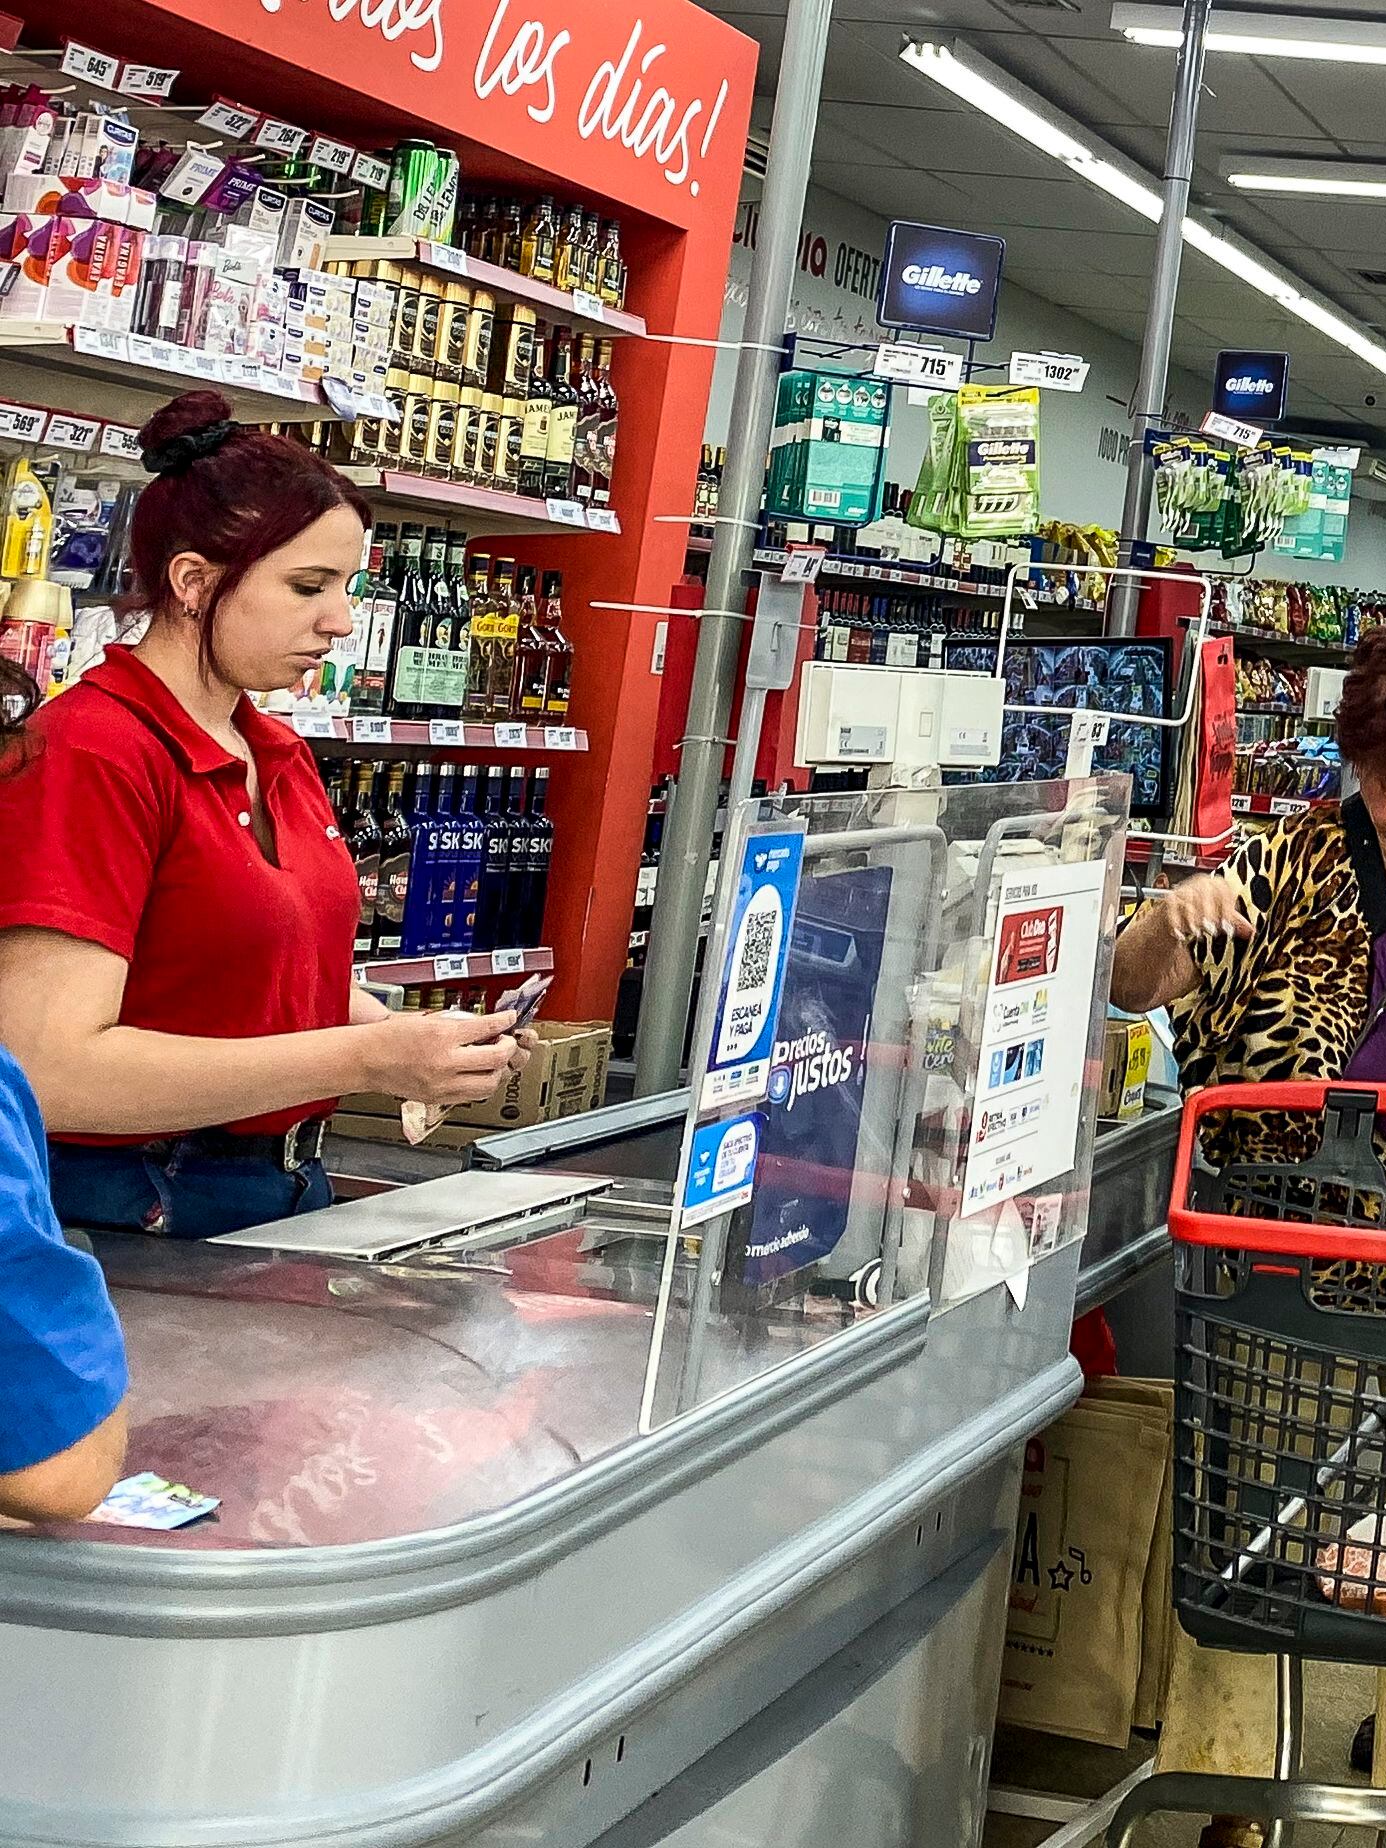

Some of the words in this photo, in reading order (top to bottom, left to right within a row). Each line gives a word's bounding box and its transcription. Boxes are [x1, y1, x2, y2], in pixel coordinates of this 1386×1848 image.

[473, 0, 571, 124] los
[577, 18, 729, 198] días!
[189, 163, 219, 178] PRIME
[227, 177, 257, 192] PRIME
[308, 206, 331, 222] CURITAS
[90, 235, 108, 281] EVAGINA
[113, 241, 132, 288] EVAGINA
[901, 264, 983, 296] Gillette
[1225, 377, 1274, 395] Gillette
[977, 441, 1029, 457] Gillette
[729, 1026, 735, 1038] Y
[773, 1029, 826, 1066] Precios
